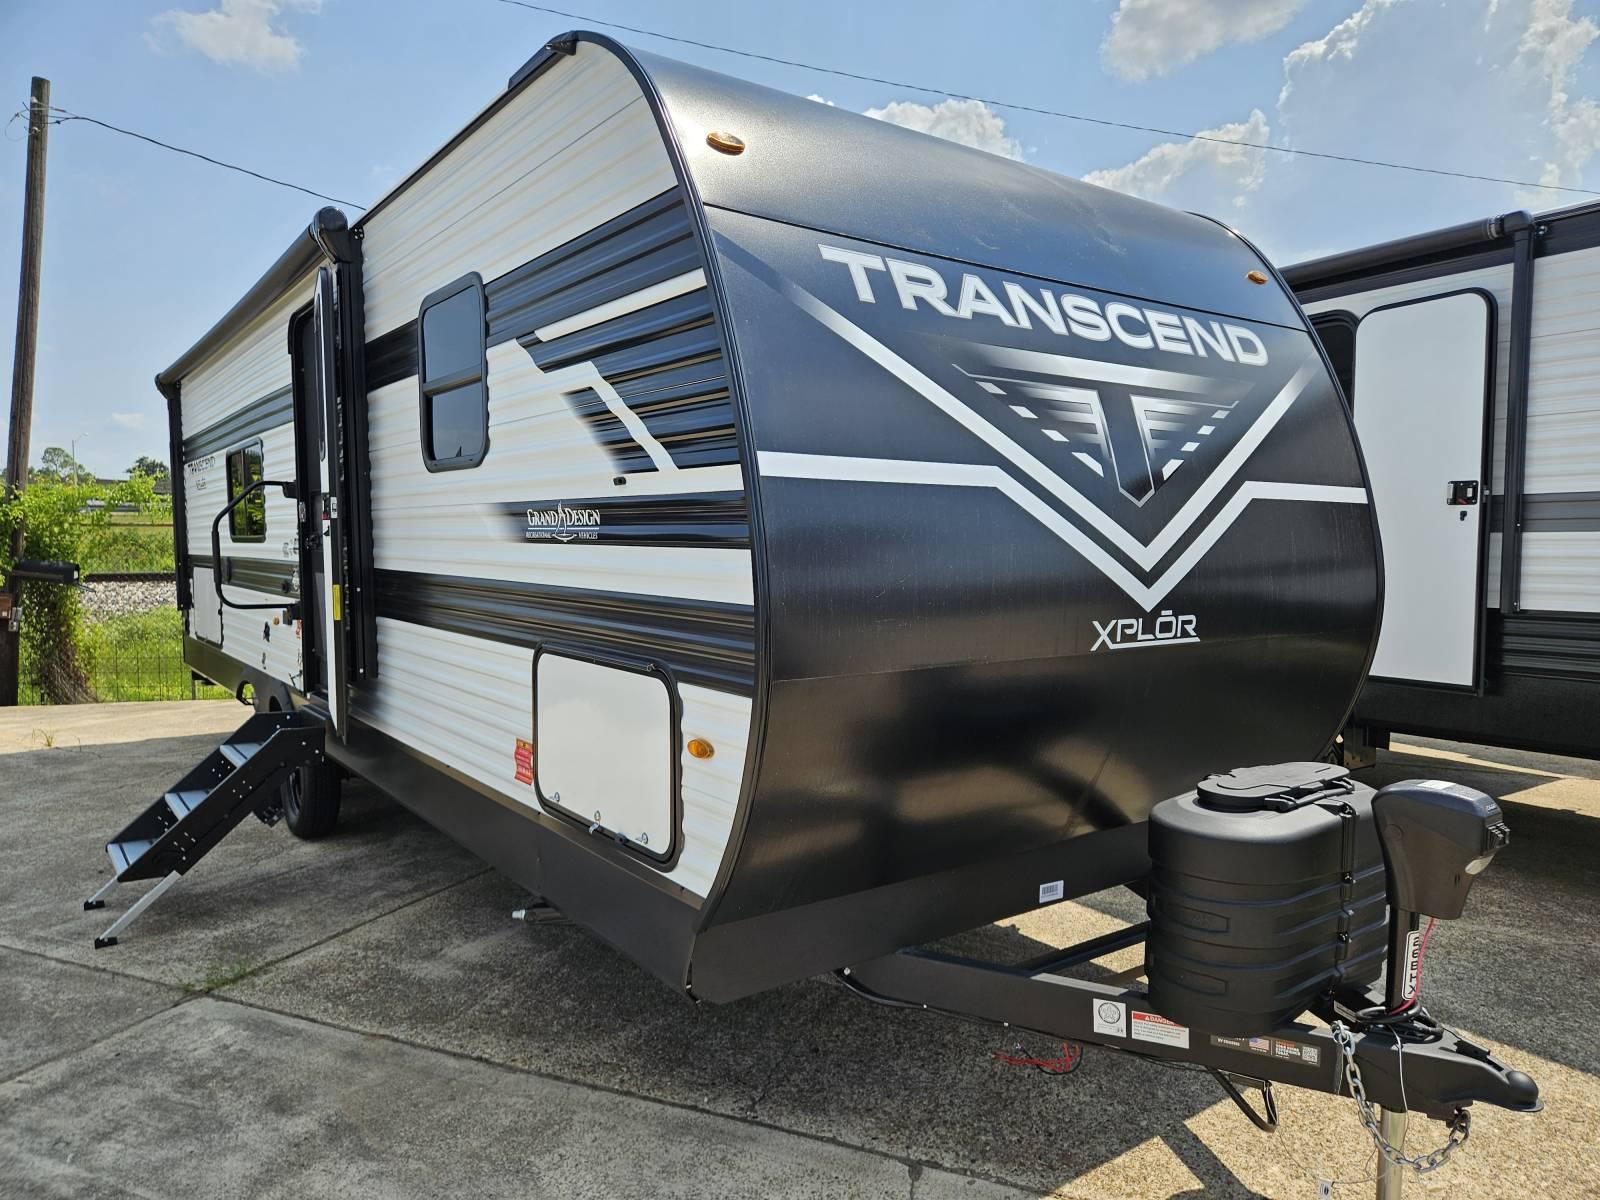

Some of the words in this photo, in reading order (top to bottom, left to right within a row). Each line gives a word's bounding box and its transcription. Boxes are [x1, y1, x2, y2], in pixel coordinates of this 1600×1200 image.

[818, 243, 1269, 367] TRANSCEND
[527, 509, 558, 526] GRAND
[564, 508, 600, 526] DESIGN
